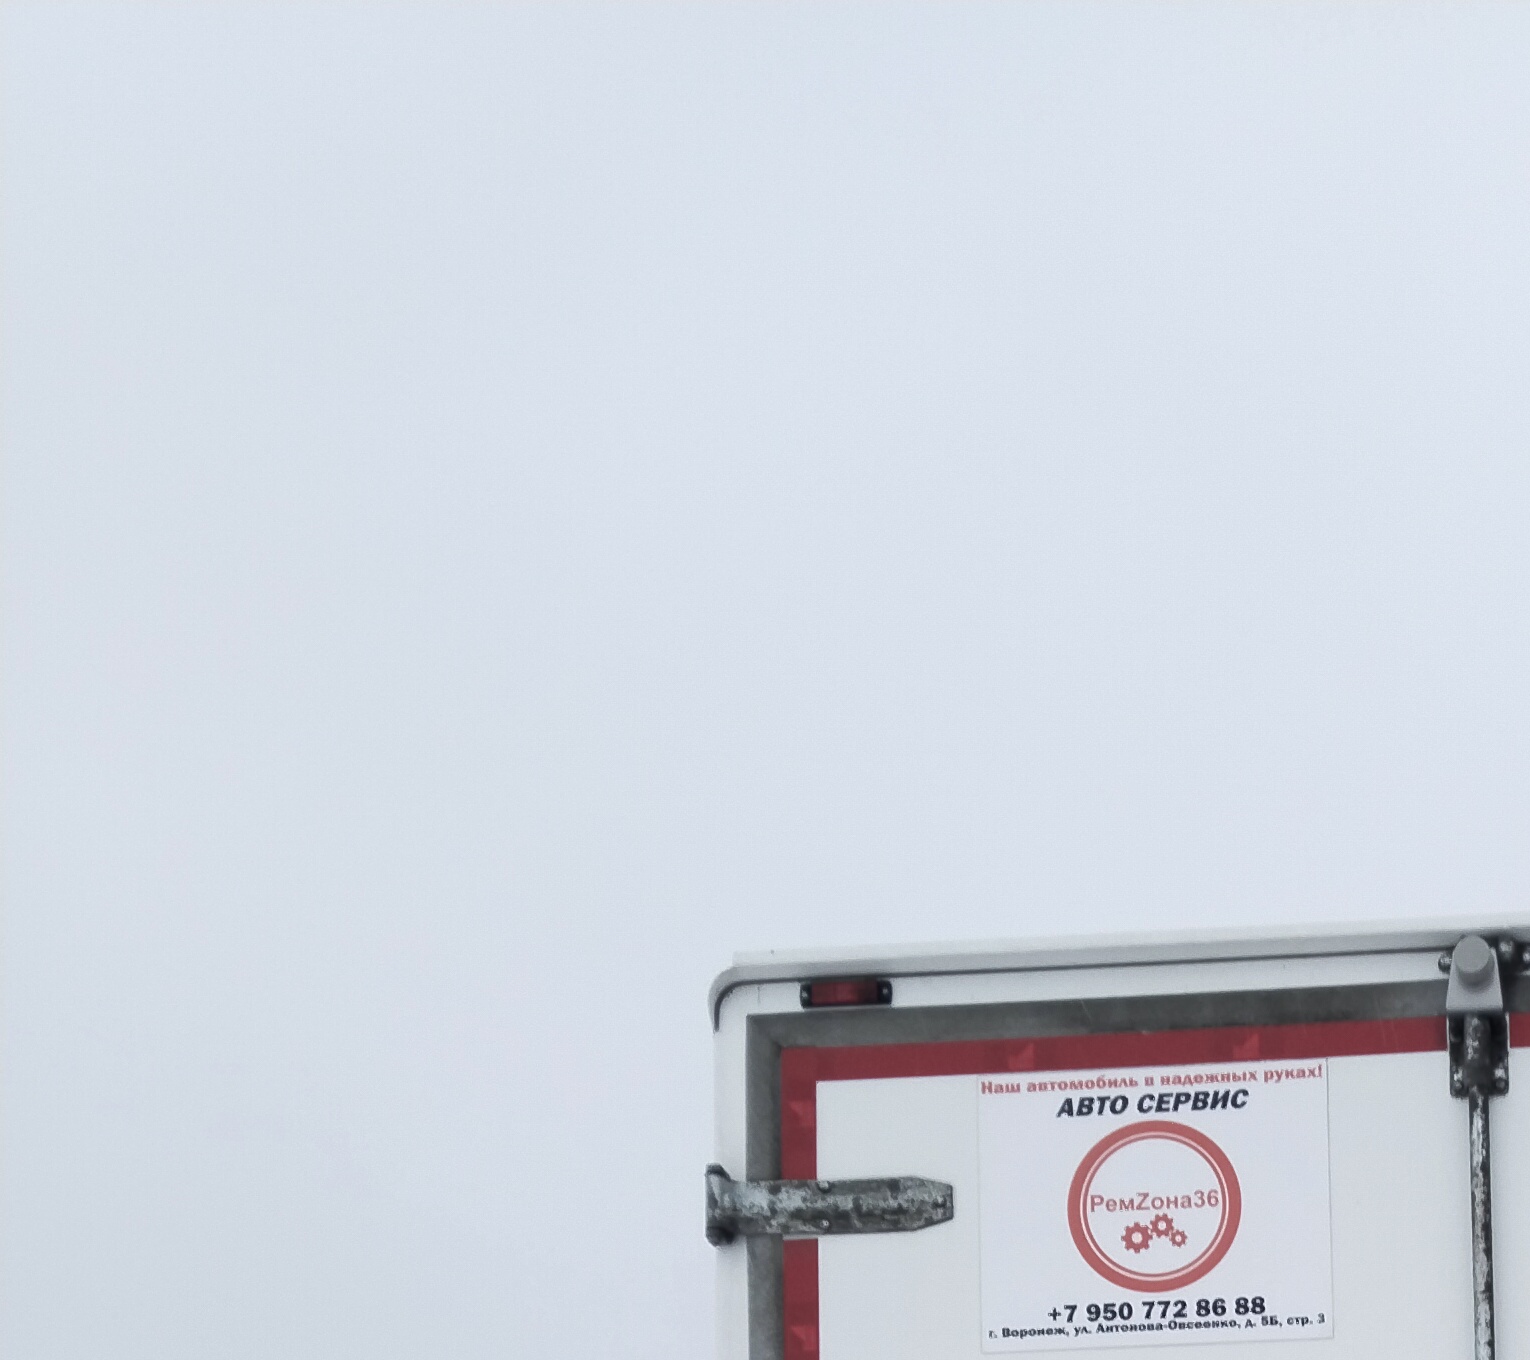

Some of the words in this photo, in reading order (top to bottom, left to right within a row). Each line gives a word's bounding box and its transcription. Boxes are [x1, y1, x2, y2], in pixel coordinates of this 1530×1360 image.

[980, 1080, 1021, 1095] Наш
[1026, 1075, 1139, 1092] автомобиль
[1144, 1075, 1155, 1087] в
[1263, 1064, 1323, 1084] руках!
[1056, 1095, 1130, 1118] АВТО
[1136, 1088, 1249, 1114] СЕРВИС
[1090, 1189, 1220, 1213] РемZона36
[1048, 1304, 1078, 1323] +7
[1086, 1302, 1133, 1322] 950
[1142, 1300, 1188, 1320] 772
[1195, 1298, 1227, 1317] 86
[1234, 1295, 1266, 1315] 88
[1002, 1326, 1070, 1339] Воронеж,
[1074, 1326, 1092, 1337] ул.
